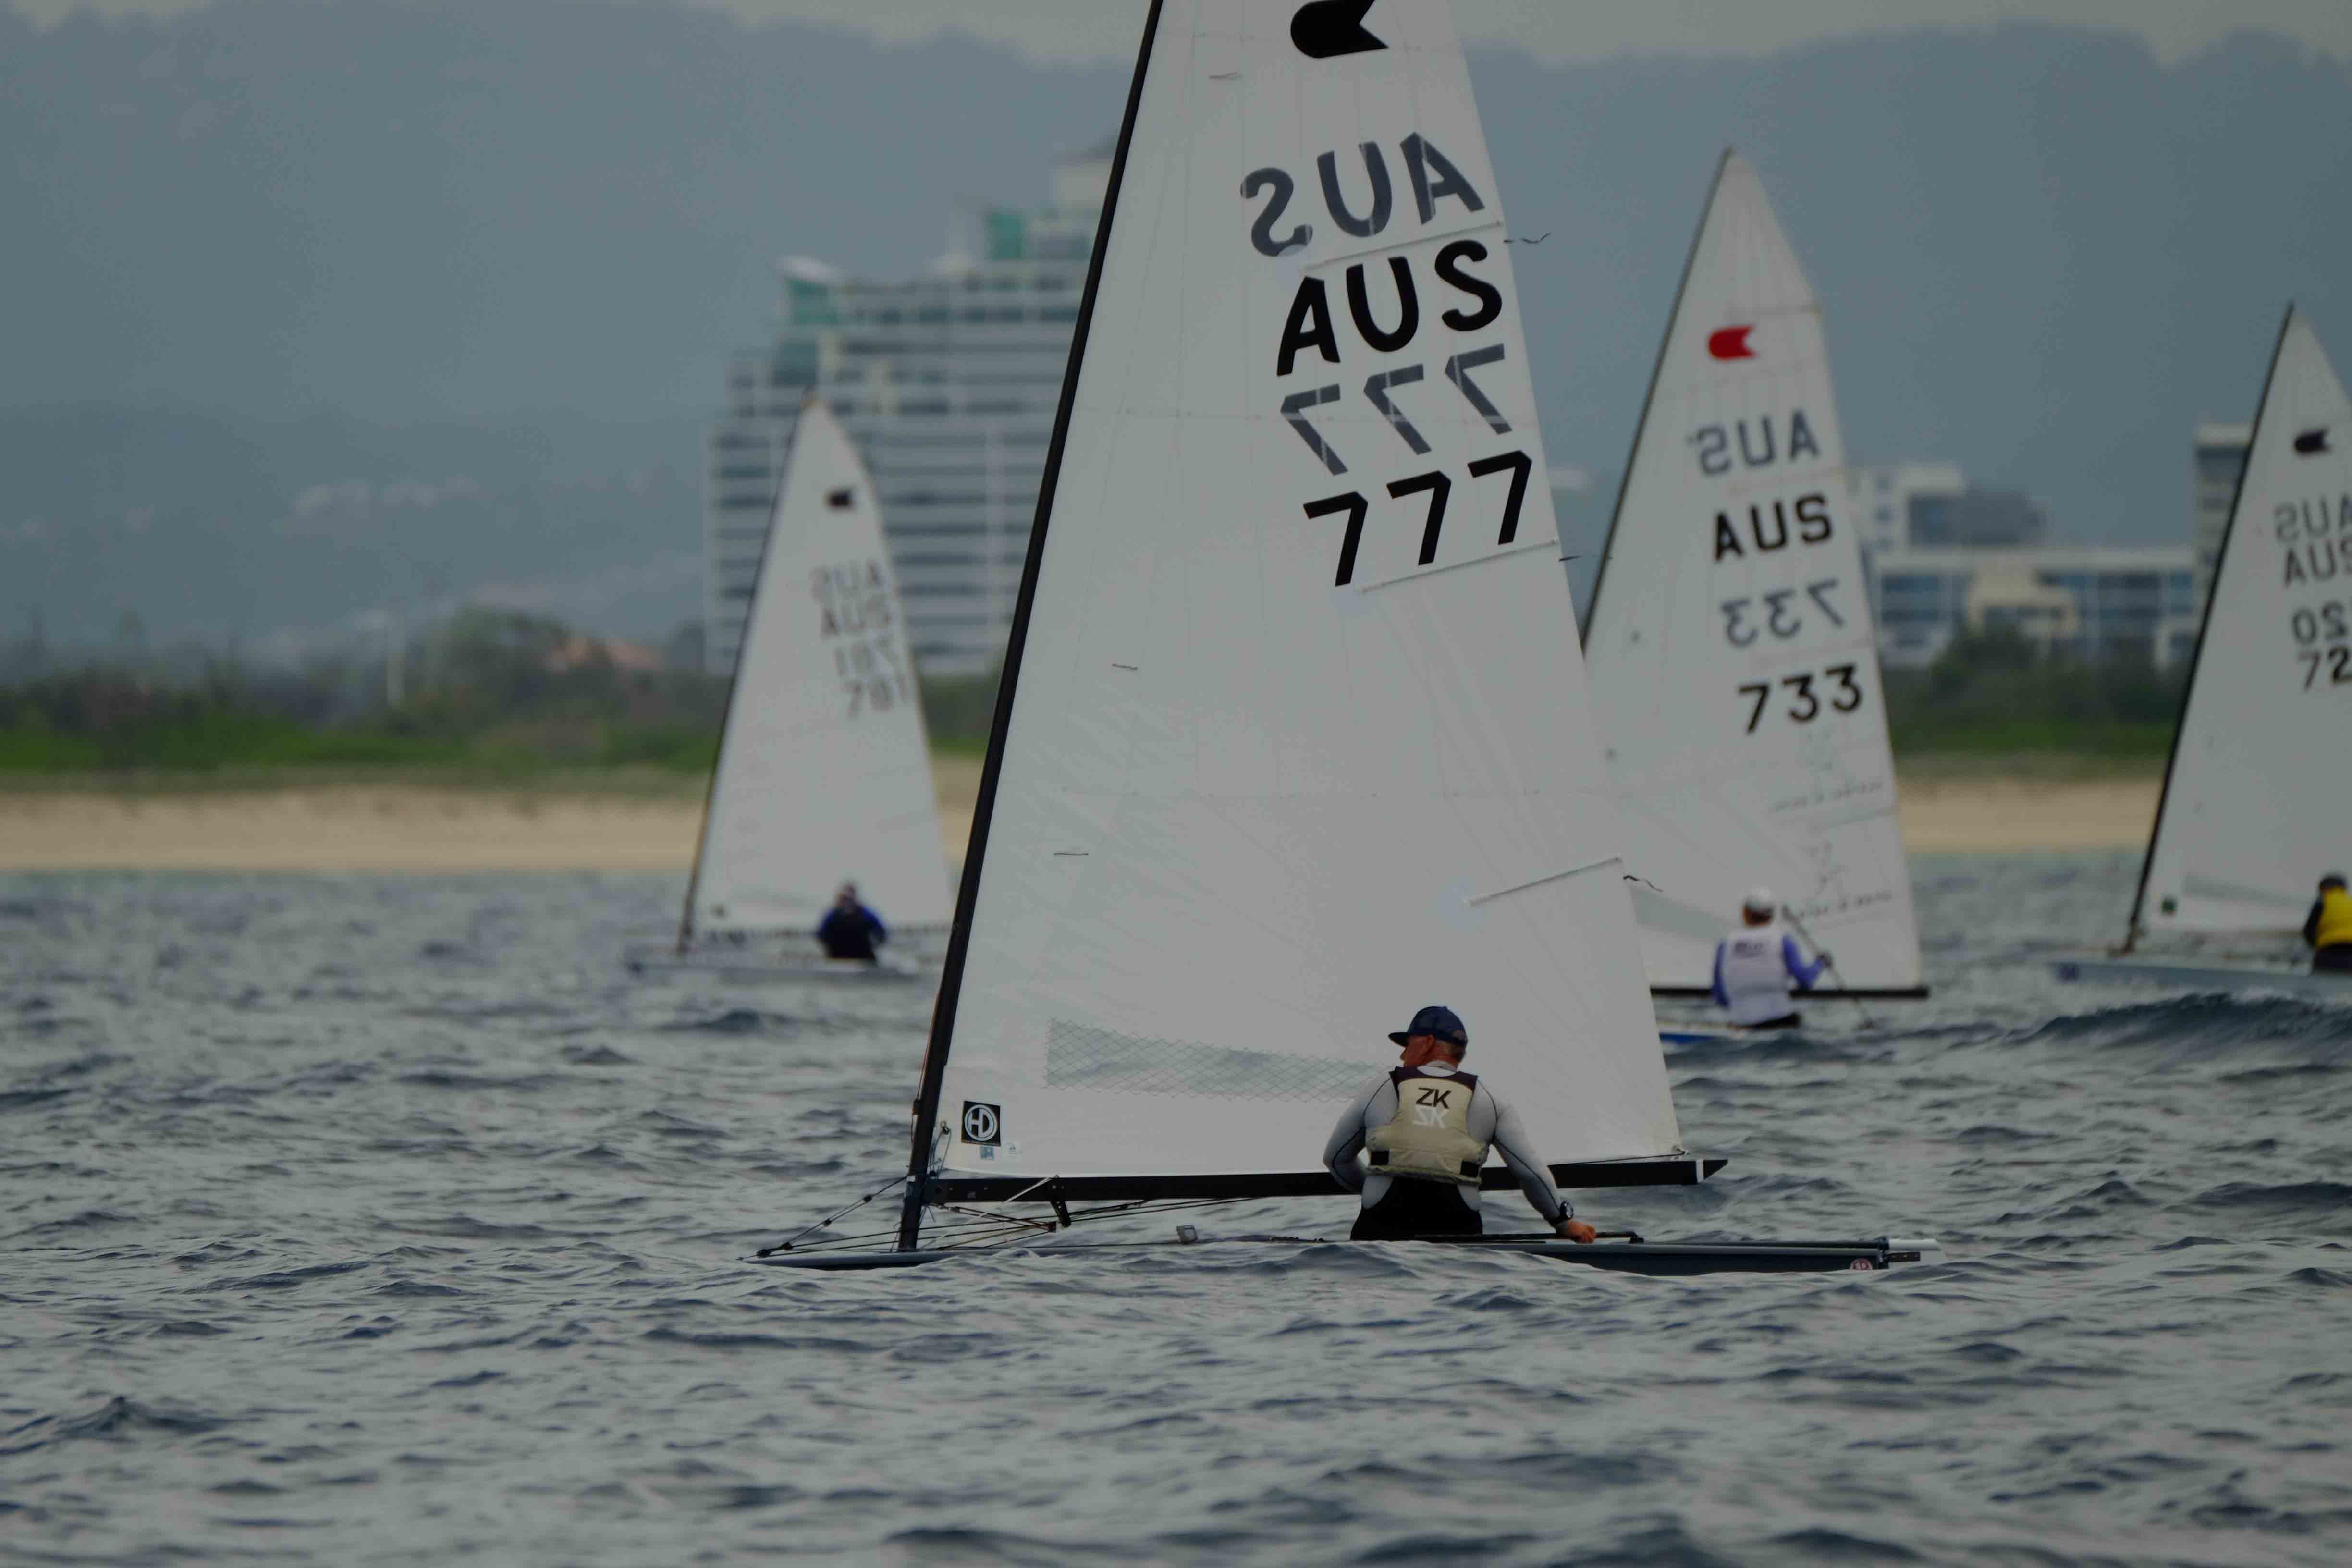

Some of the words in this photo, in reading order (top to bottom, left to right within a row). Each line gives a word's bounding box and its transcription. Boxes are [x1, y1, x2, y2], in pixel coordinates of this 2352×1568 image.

[1276, 240, 1503, 377] AUS
[1302, 450, 1533, 587] 777
[1715, 493, 1833, 562] AUS
[1738, 663, 1863, 735] 733
[1415, 1087, 1452, 1109] ZK
